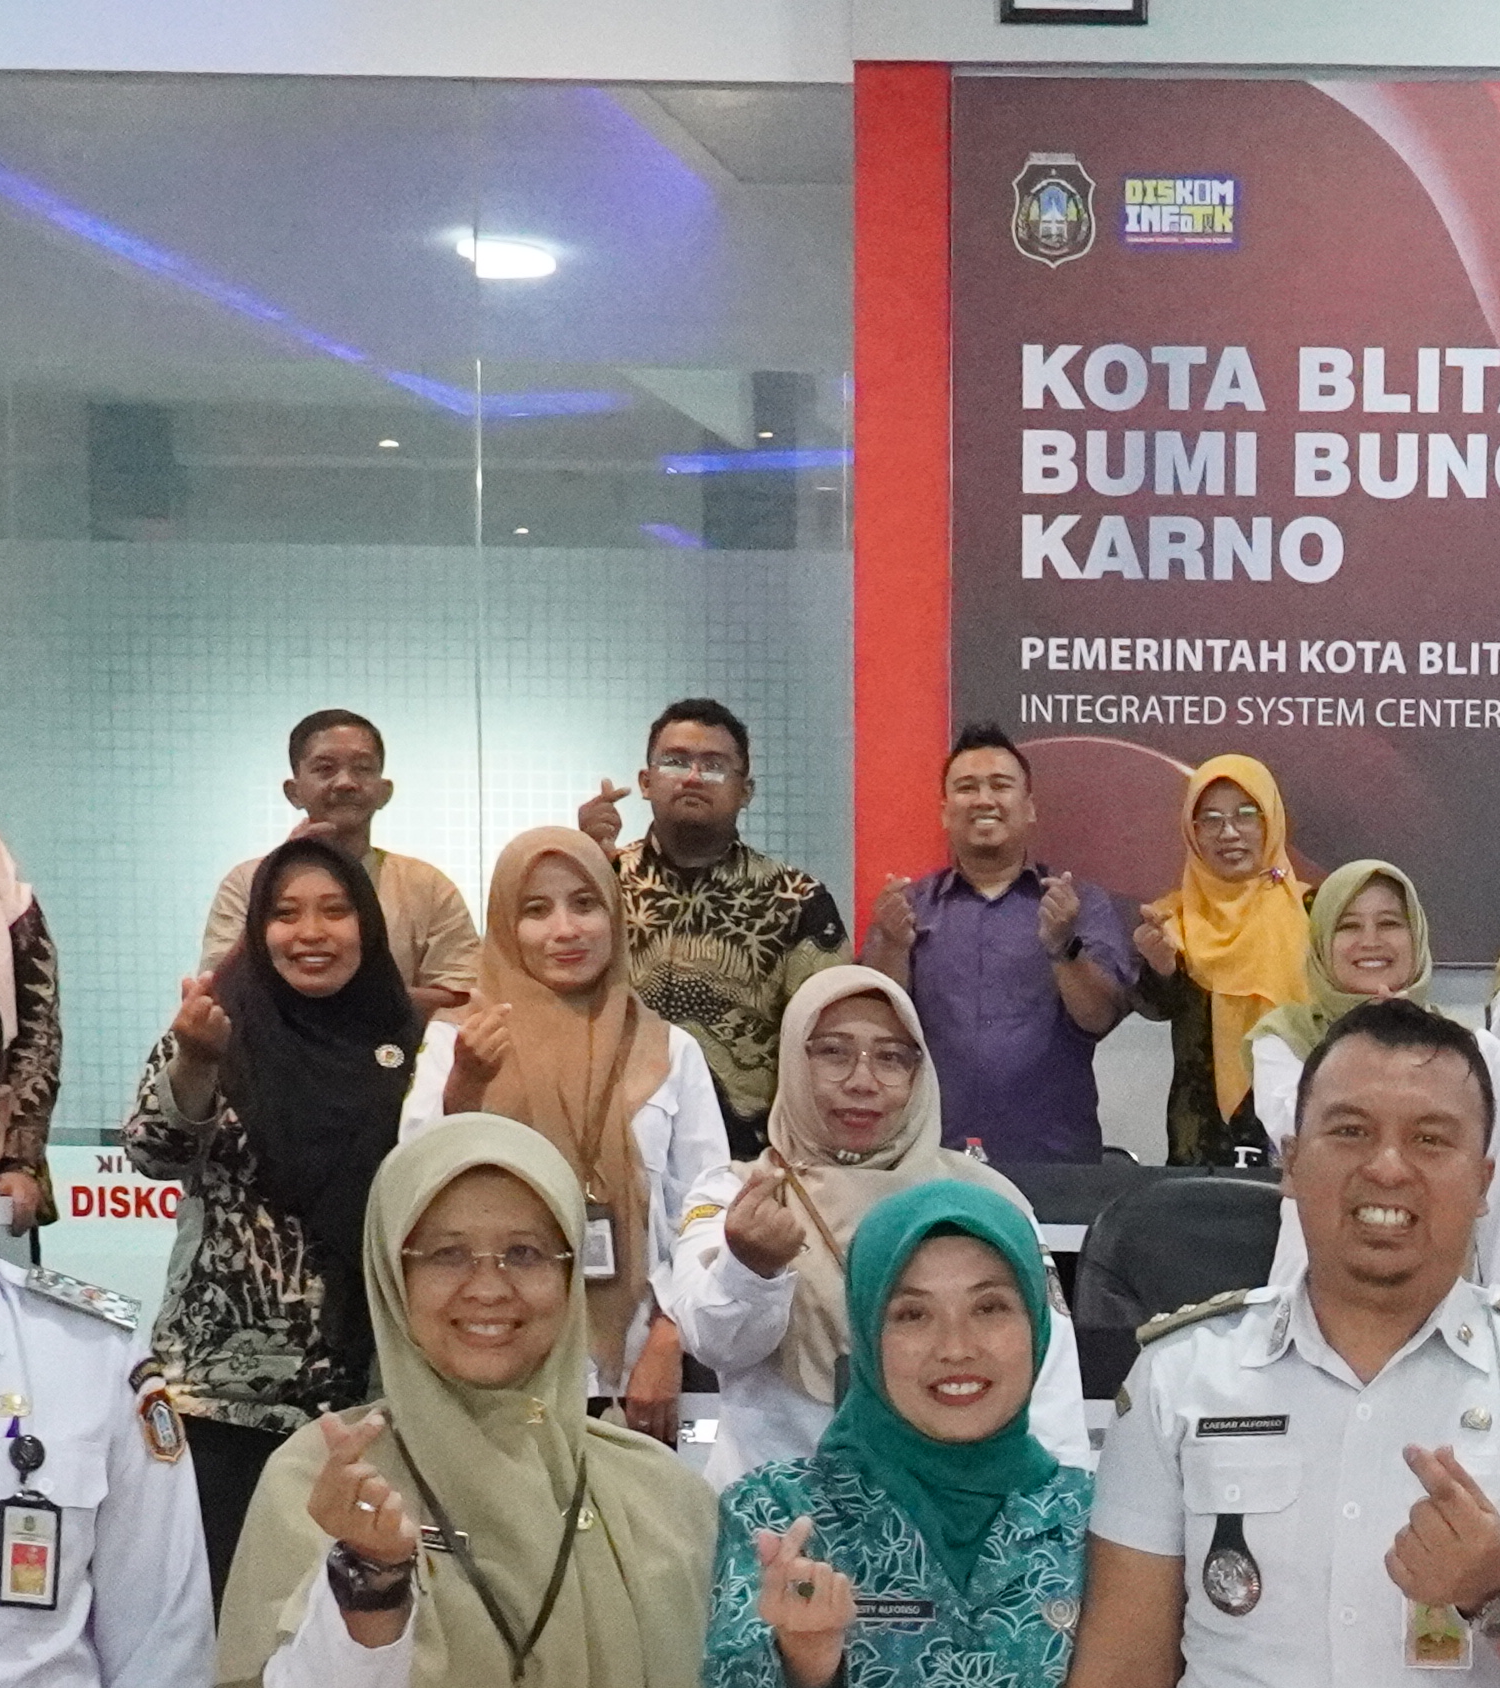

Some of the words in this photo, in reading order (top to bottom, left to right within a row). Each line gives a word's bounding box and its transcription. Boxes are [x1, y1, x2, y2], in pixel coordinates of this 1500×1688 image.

[1124, 179, 1235, 205] DISKOM
[1021, 343, 1267, 412] KOTA
[1021, 429, 1257, 497] BUMI
[1021, 513, 1345, 584] KARNO
[1020, 637, 1287, 673] PEMERINTAH
[1299, 640, 1407, 674] KOTA
[1020, 694, 1227, 725] INTEGRATED
[1235, 696, 1365, 727] SYSTEM
[71, 1185, 182, 1220] DISKO
[878, 1604, 920, 1615] ALFONSO
